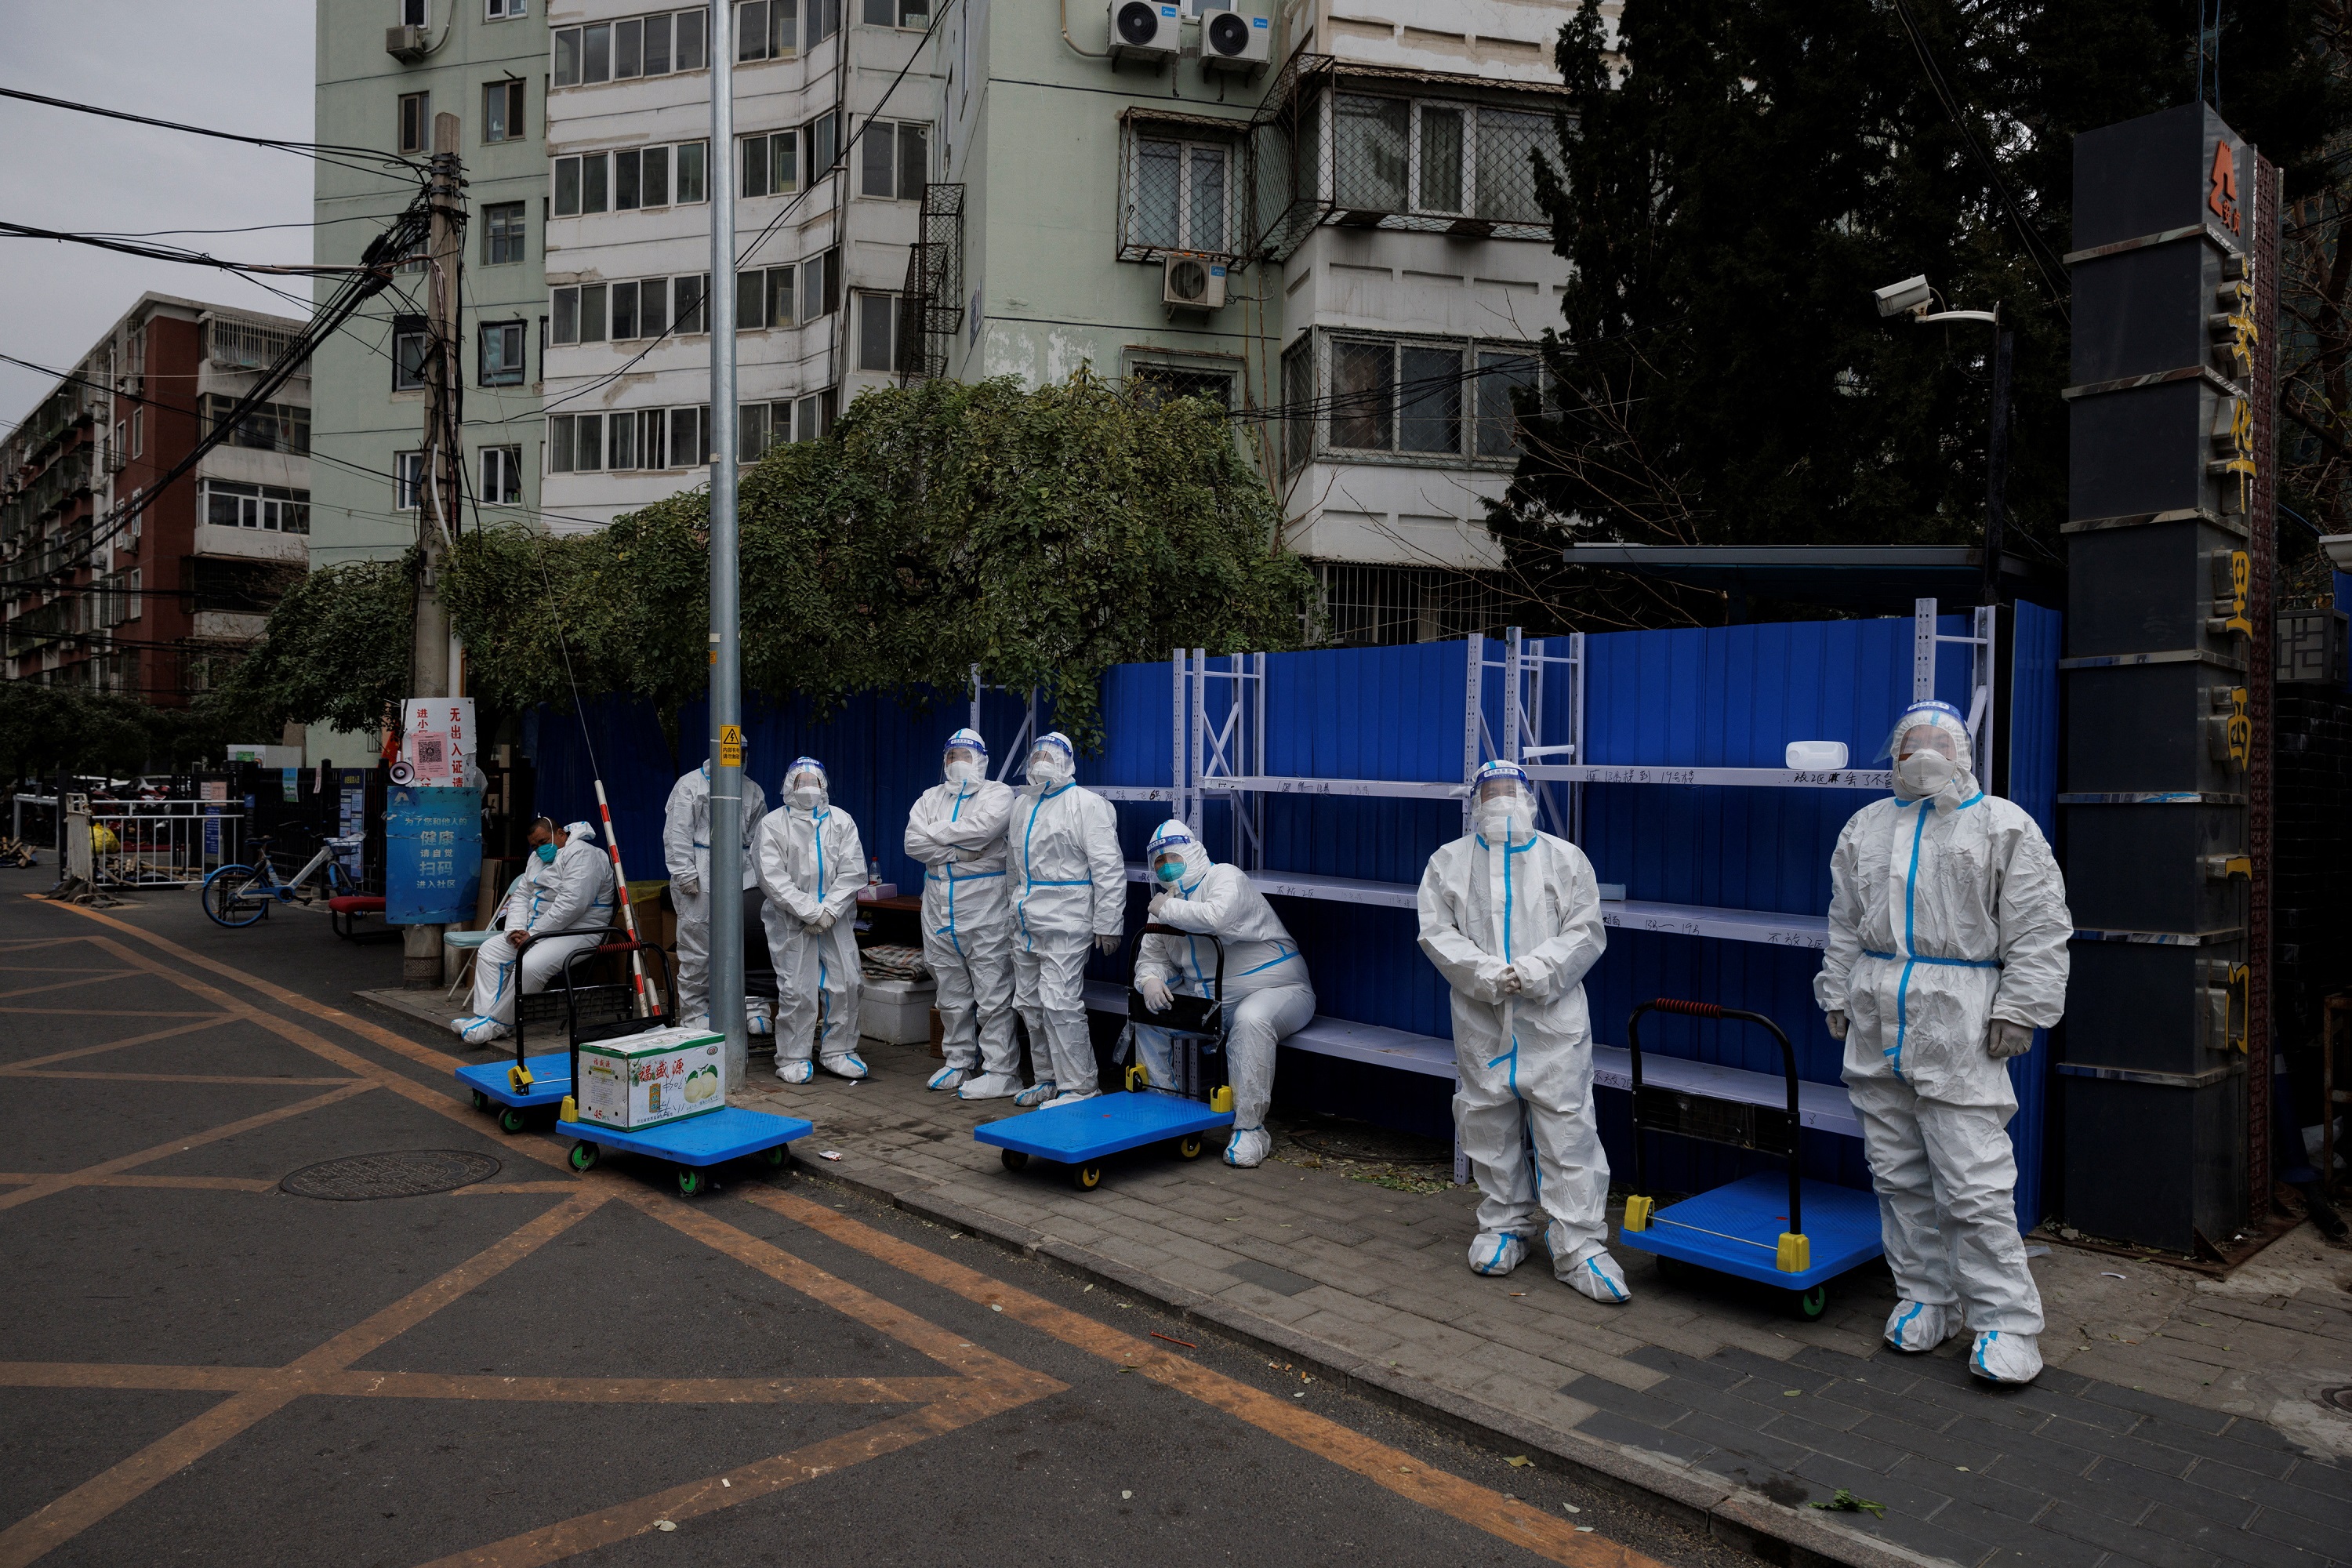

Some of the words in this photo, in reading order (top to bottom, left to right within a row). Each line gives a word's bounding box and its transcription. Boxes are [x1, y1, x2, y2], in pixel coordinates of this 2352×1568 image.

[2222, 199, 2241, 237] 安贞
[405, 817, 467, 826] 为了您和他人的
[420, 830, 455, 846] 健康
[420, 848, 453, 858] 请自觉
[419, 861, 453, 877] 扫码
[416, 880, 456, 889] 进入社区
[593, 1058, 611, 1068] 福盛源
[637, 1058, 684, 1083] 福盛源
[593, 1109, 603, 1120] 45
